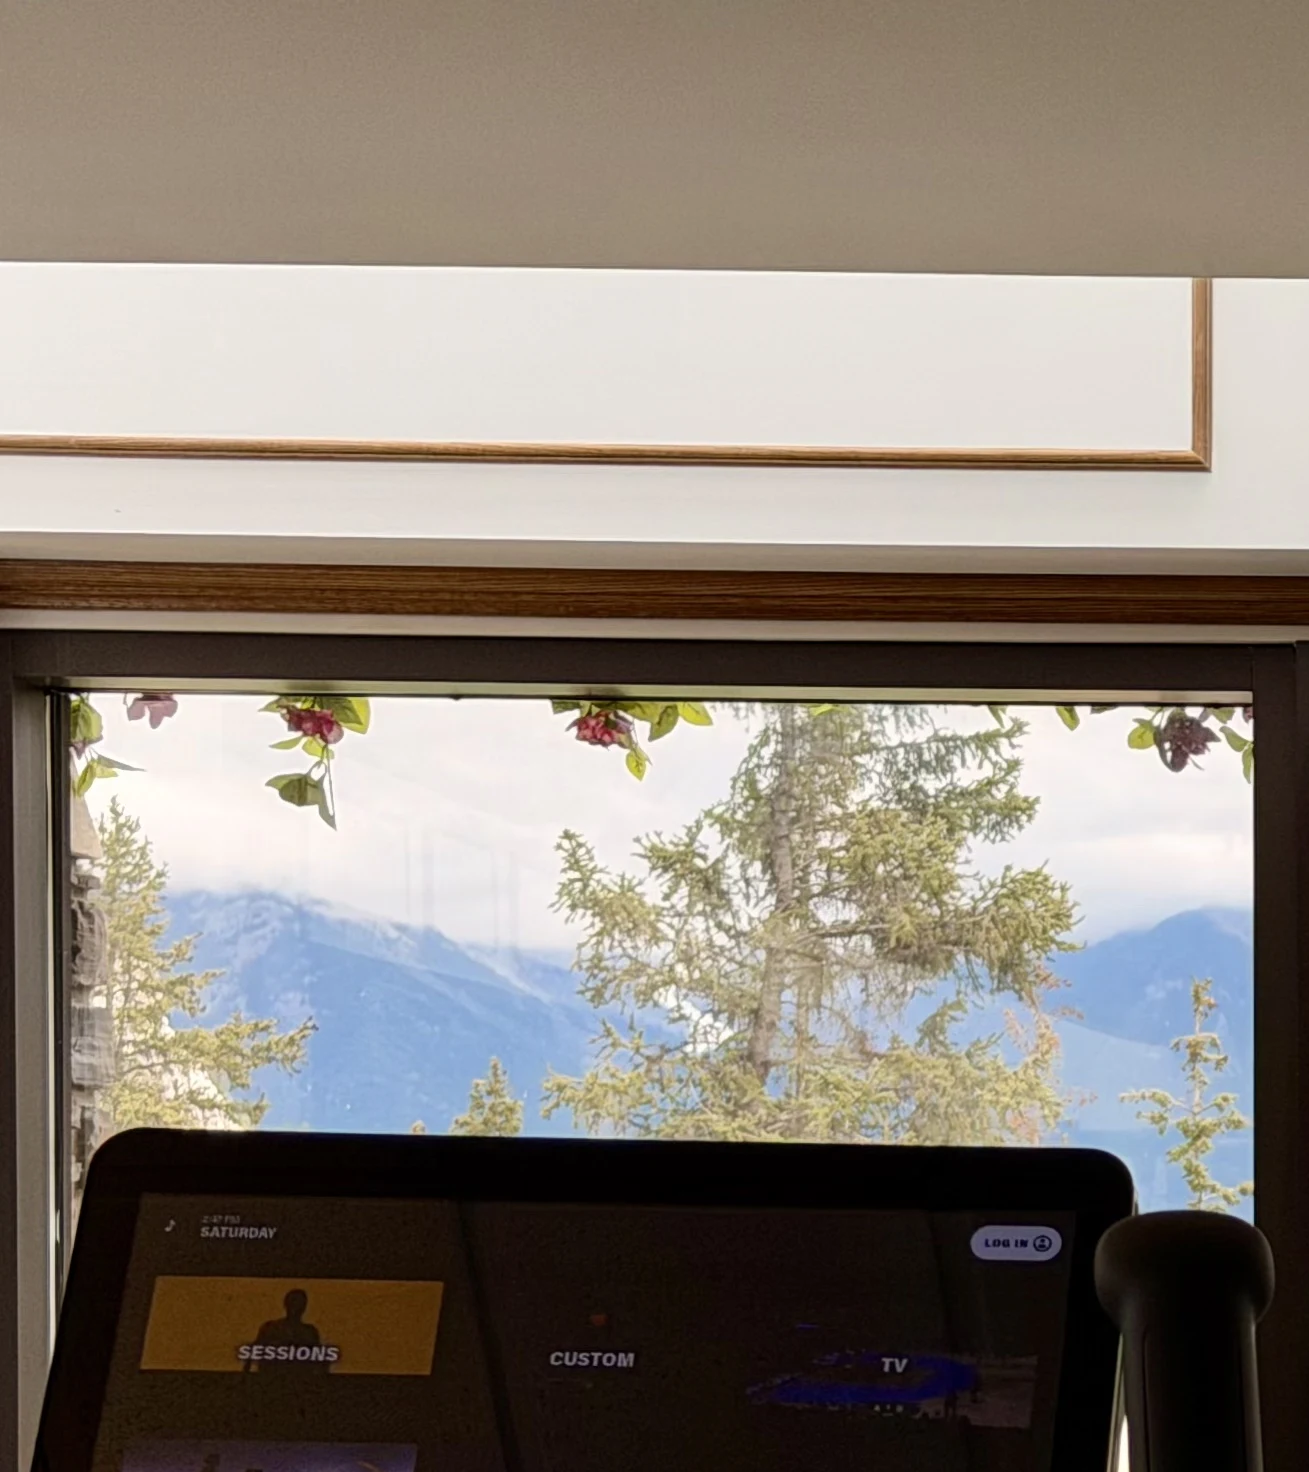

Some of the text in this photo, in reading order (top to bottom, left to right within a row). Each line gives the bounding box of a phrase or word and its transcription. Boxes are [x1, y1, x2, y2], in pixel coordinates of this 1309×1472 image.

[200, 1226, 277, 1239] SATURDAY
[984, 1239, 1028, 1248] LOG IN
[237, 1345, 339, 1361] SESSIONS
[549, 1351, 635, 1368] CUSTOM
[881, 1357, 908, 1373] TV
